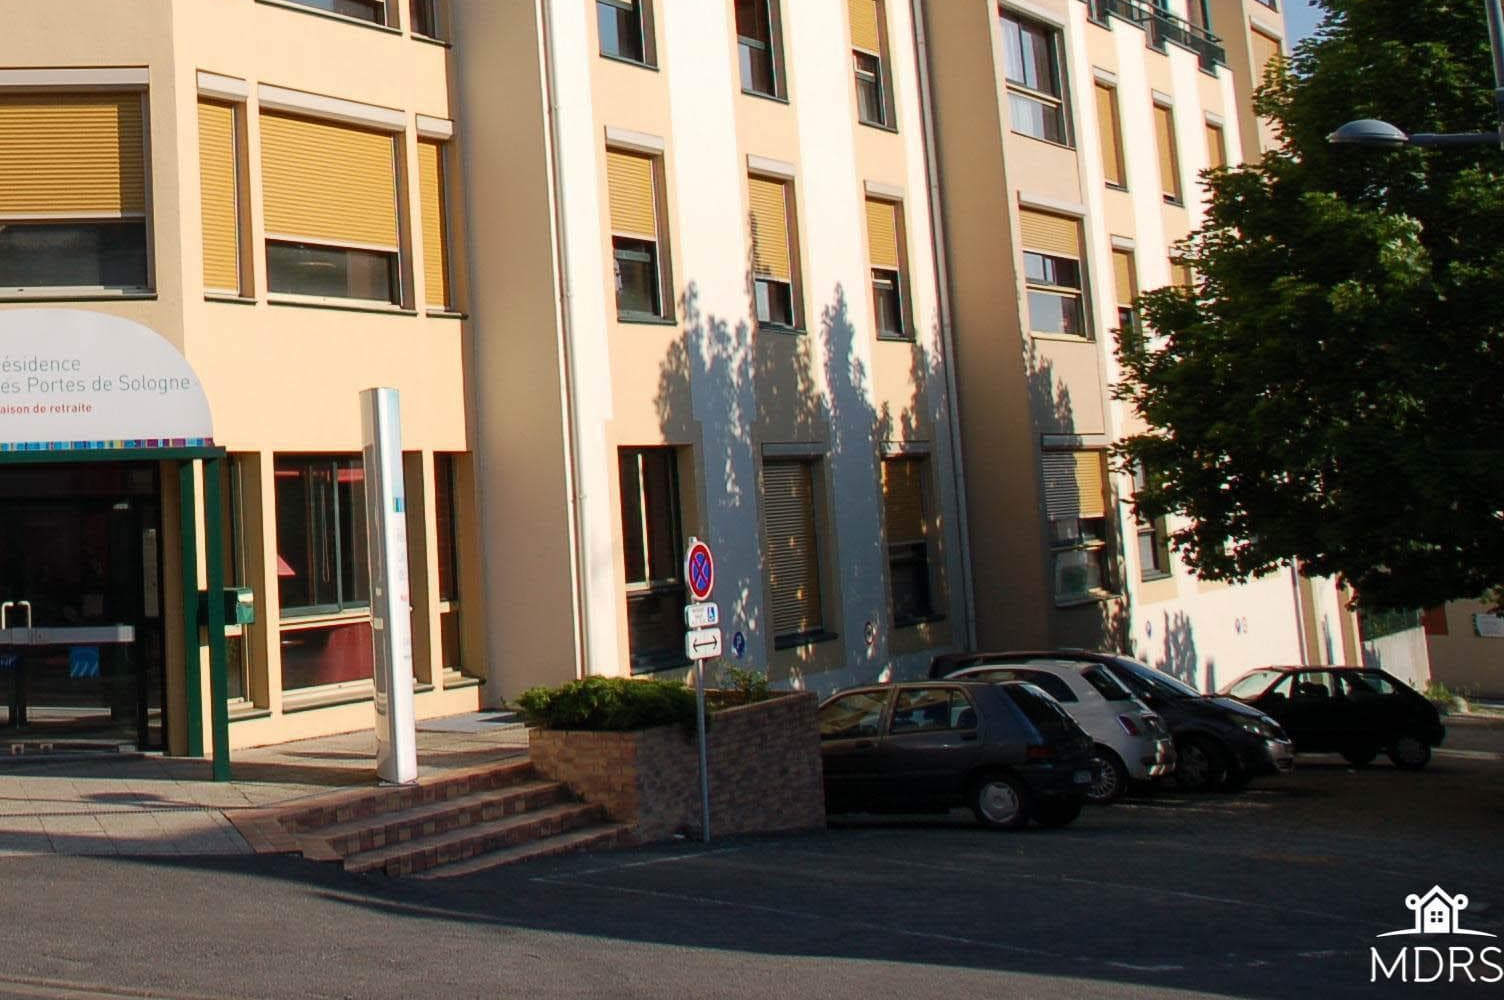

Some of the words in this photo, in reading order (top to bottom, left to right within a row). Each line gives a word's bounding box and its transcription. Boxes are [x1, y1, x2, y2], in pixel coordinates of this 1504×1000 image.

[27, 376, 86, 392] Portes
[92, 375, 112, 391] de
[119, 374, 190, 395] Sologne
[33, 404, 46, 413] de
[50, 402, 93, 413] retraite
